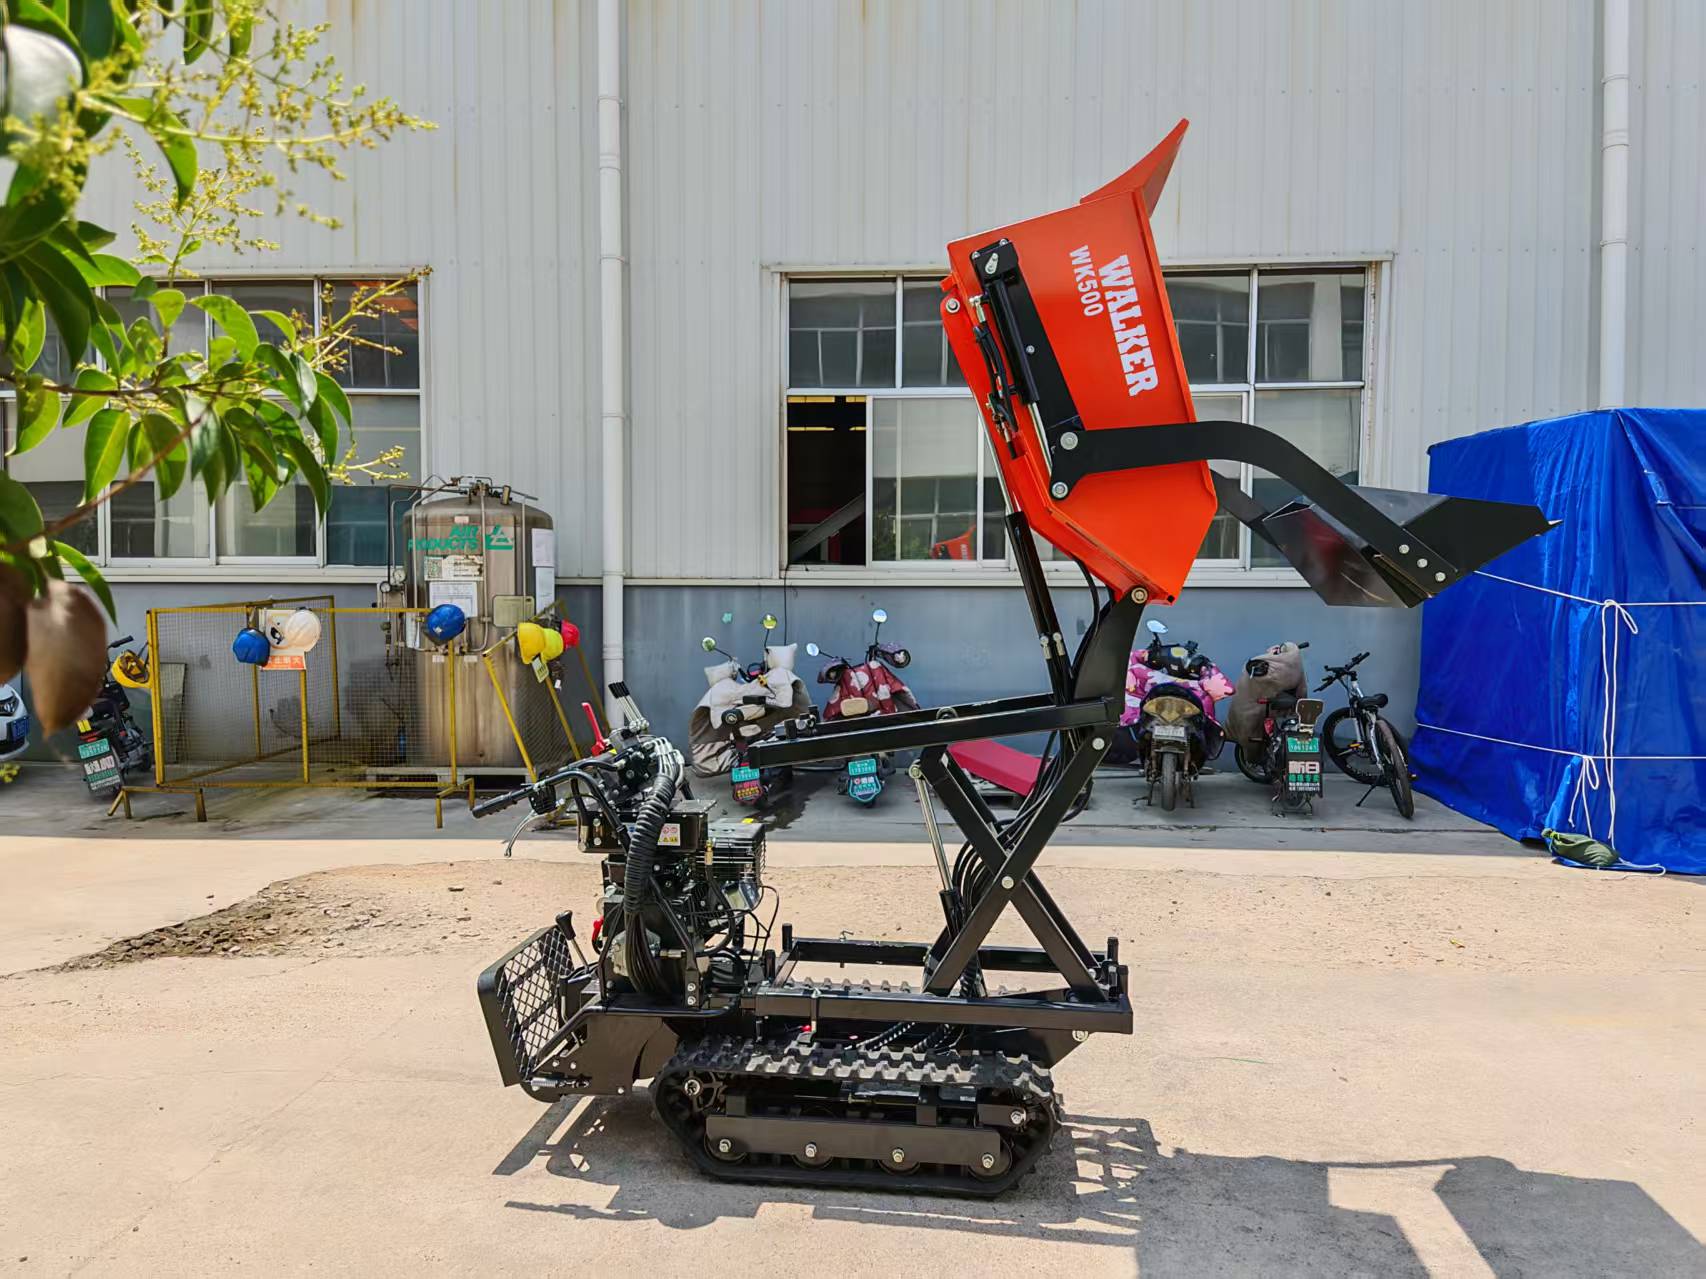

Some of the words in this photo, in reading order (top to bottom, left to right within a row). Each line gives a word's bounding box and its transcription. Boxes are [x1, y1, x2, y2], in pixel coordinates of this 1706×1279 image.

[1069, 244, 1104, 317] WK500
[1098, 254, 1159, 397] WALKER
[449, 524, 479, 538] AIR
